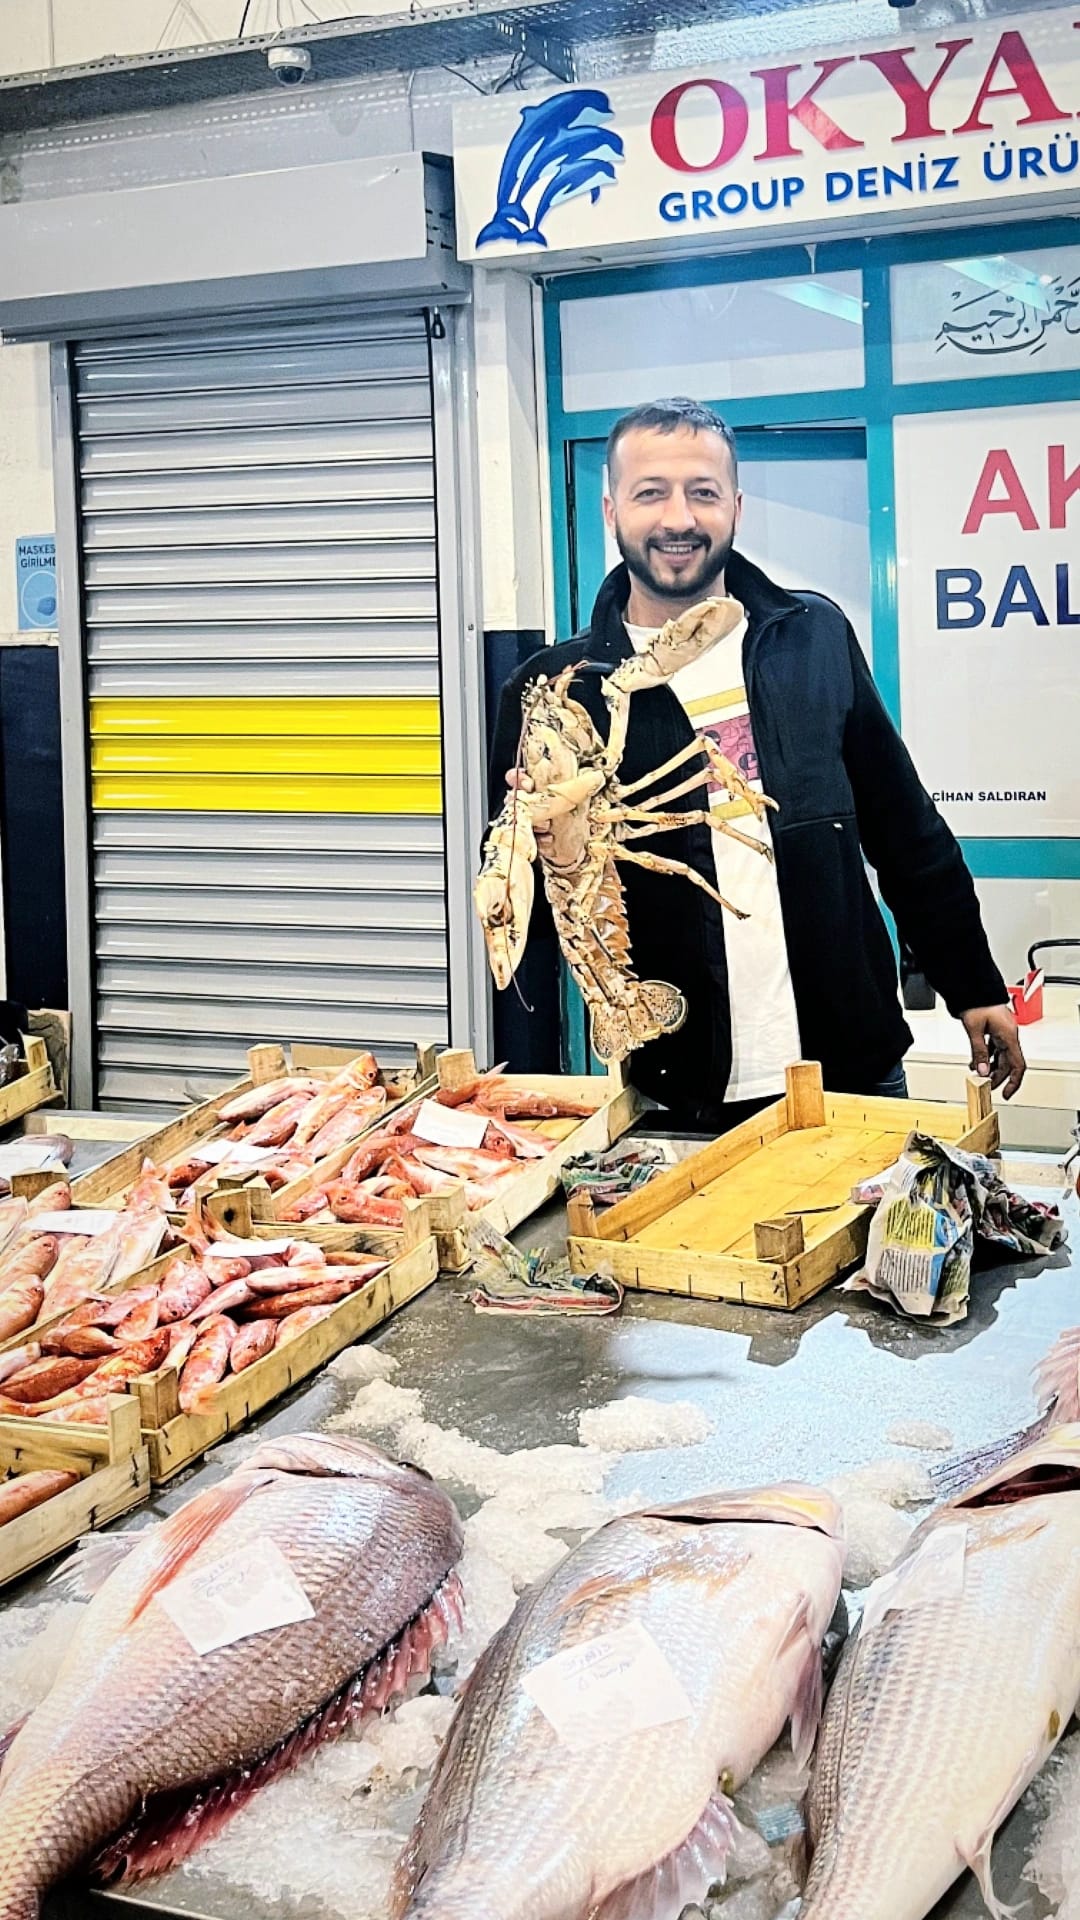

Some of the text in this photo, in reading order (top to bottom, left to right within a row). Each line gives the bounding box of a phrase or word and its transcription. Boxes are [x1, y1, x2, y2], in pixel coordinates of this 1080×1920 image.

[650, 22, 1080, 173] OKYA
[658, 132, 1080, 223] GROUP DENİZ ÜRÜ
[961, 444, 1080, 535] AK
[935, 563, 1080, 630] BAL
[931, 790, 1047, 802] CİHAN SALDIRAN
